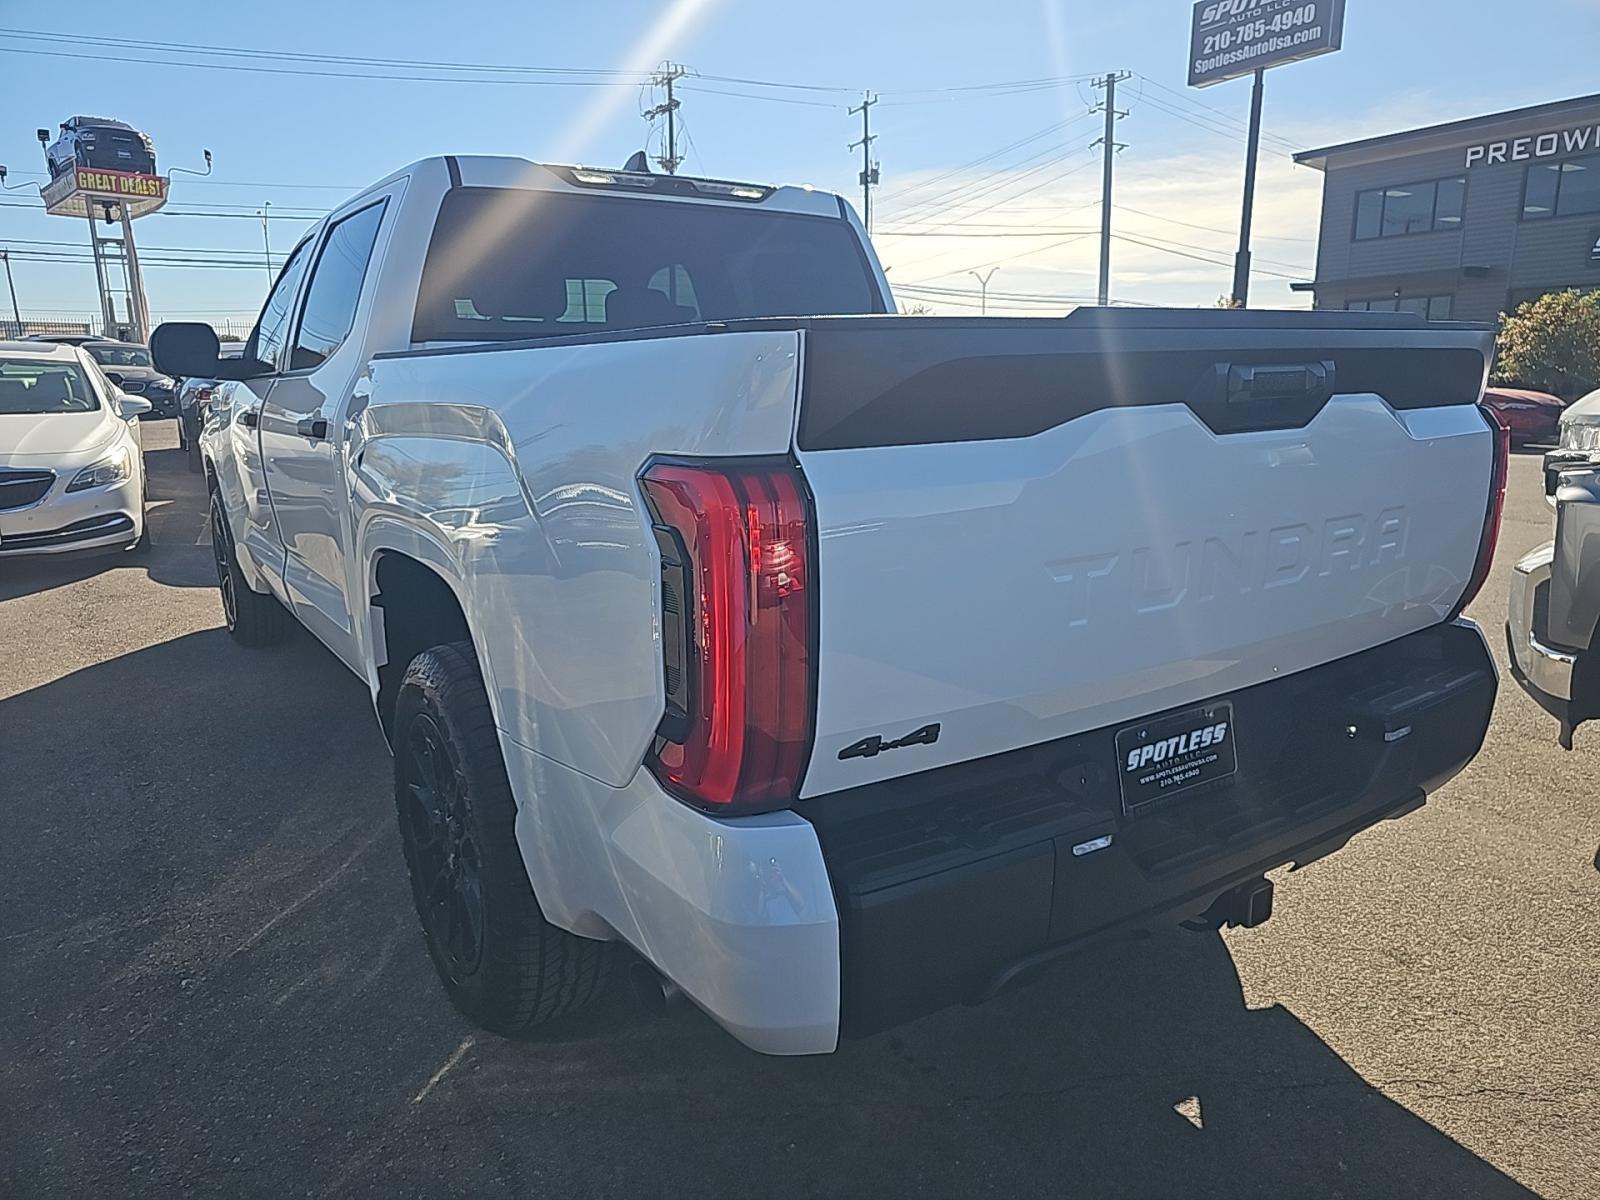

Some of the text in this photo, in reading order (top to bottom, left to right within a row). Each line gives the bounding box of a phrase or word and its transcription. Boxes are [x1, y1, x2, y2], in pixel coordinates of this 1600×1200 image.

[1203, 3, 1316, 55] 210-785-4940
[1228, 8, 1262, 25] AUTO
[1194, 26, 1322, 74] SpotlessAutoUsa.com
[78, 172, 161, 196] GREAT DEALS!
[1043, 504, 1410, 627] TUNDRA
[837, 722, 941, 761] 4x4
[1126, 722, 1228, 772] SPOTLESS
